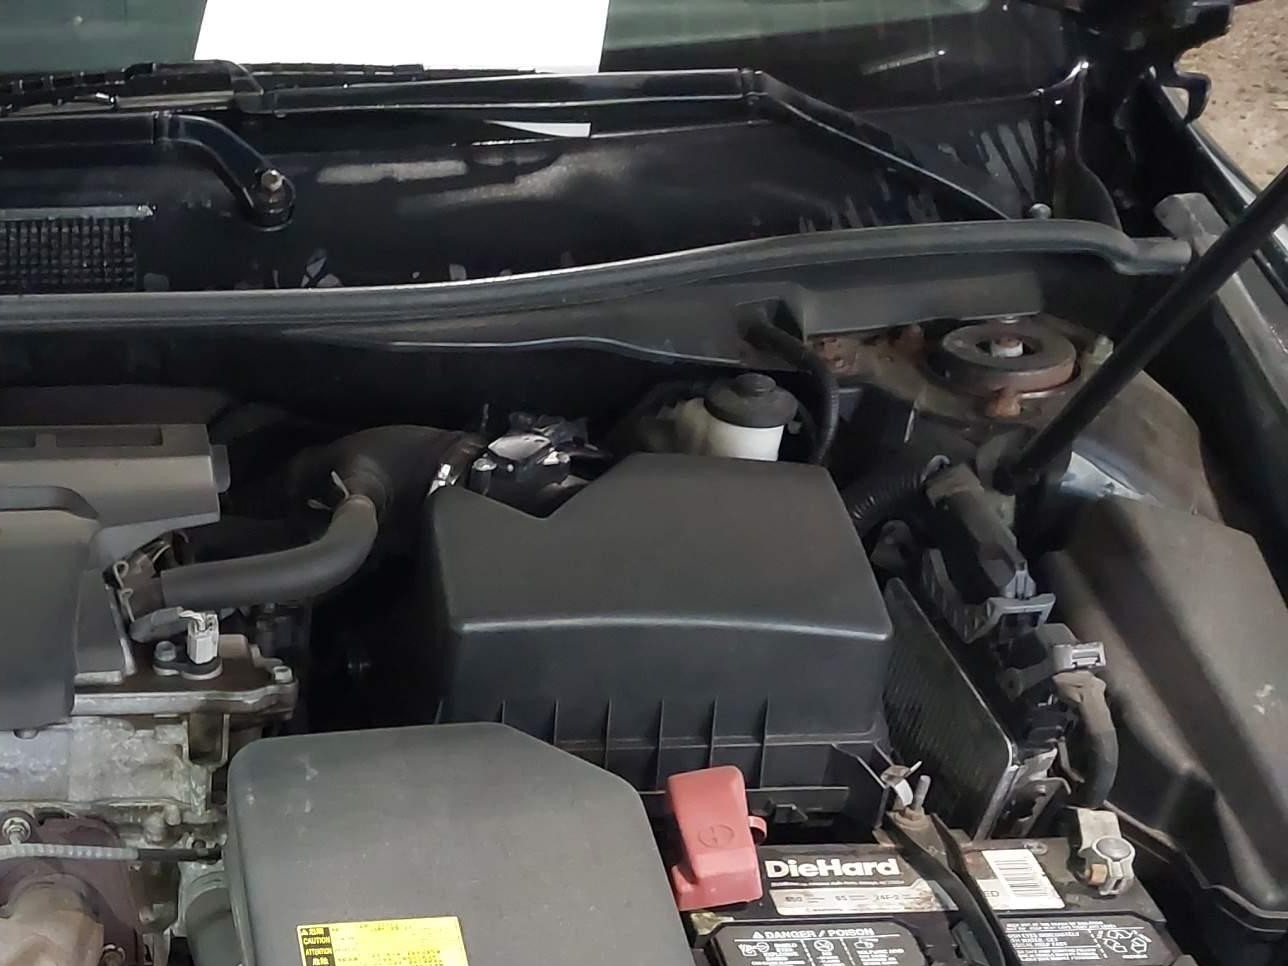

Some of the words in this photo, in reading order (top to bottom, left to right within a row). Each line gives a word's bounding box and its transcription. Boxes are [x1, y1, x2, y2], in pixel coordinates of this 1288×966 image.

[764, 858, 902, 878] DieHard
[765, 929, 816, 939] DANGER
[828, 928, 875, 937] POISON
[303, 936, 331, 946] CAUTION
[305, 947, 333, 956] ATTENTION
